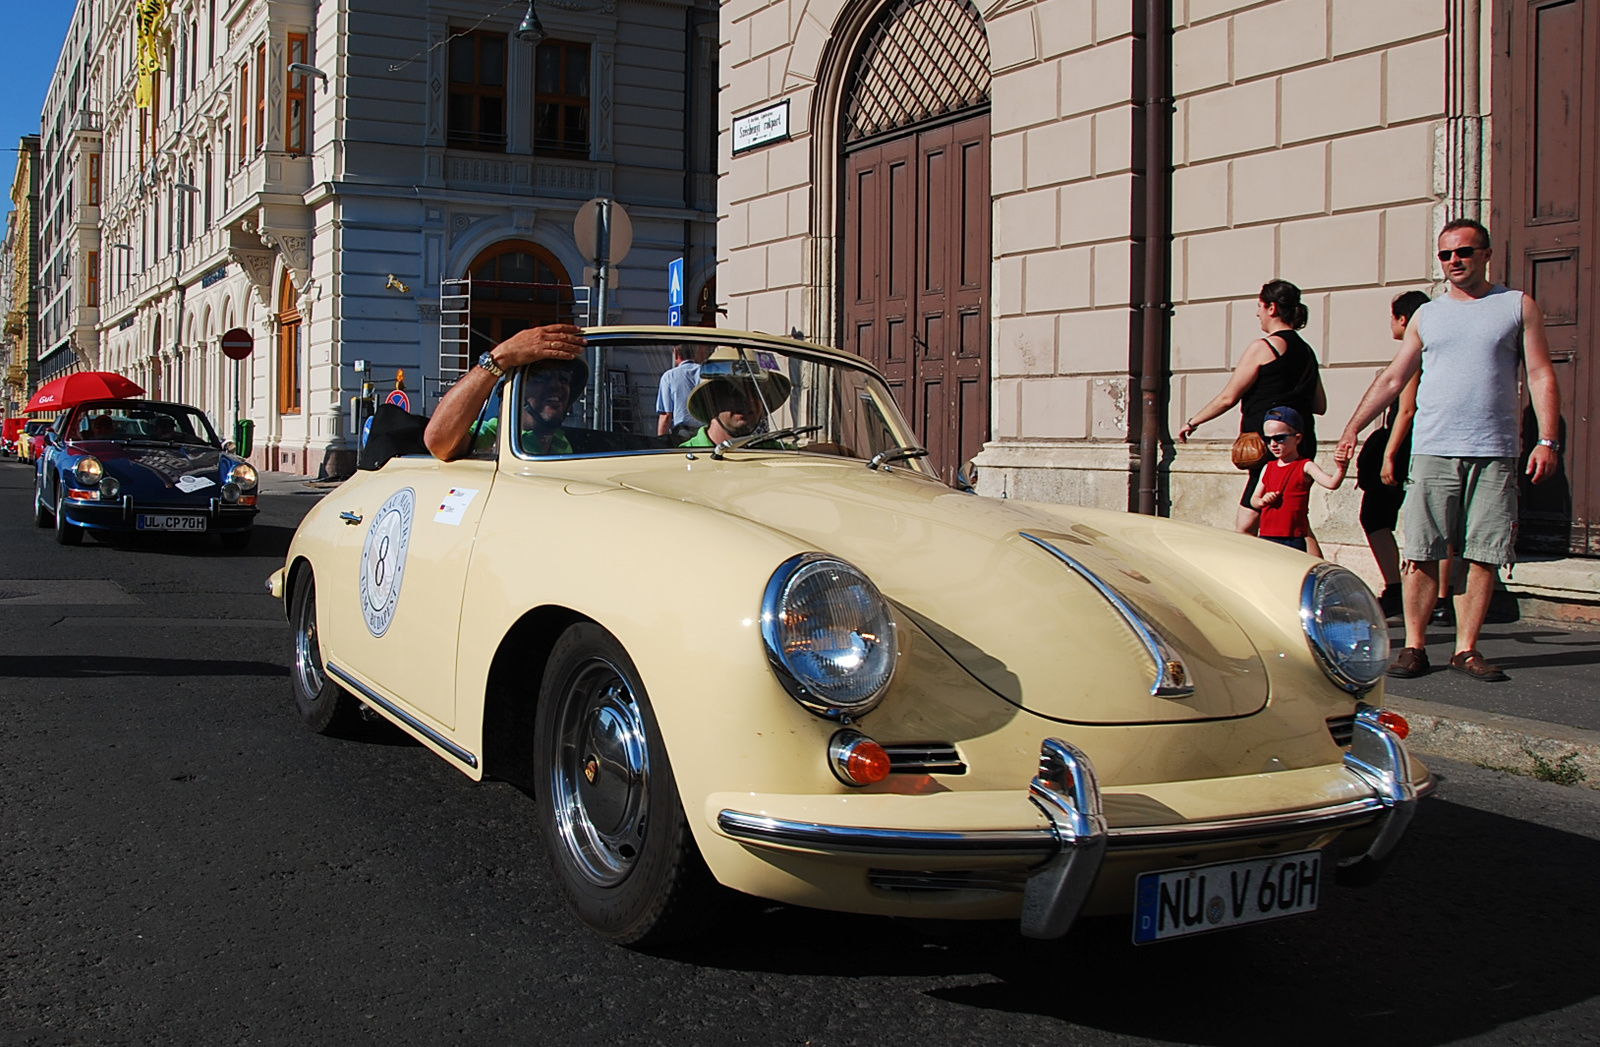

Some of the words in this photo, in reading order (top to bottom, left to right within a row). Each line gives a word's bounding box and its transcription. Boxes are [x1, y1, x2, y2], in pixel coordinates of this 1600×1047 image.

[671, 311, 678, 326] P
[375, 535, 389, 587] 8
[1230, 869, 1251, 918] V
[1257, 858, 1319, 913] 60H
[1142, 915, 1150, 930] D
